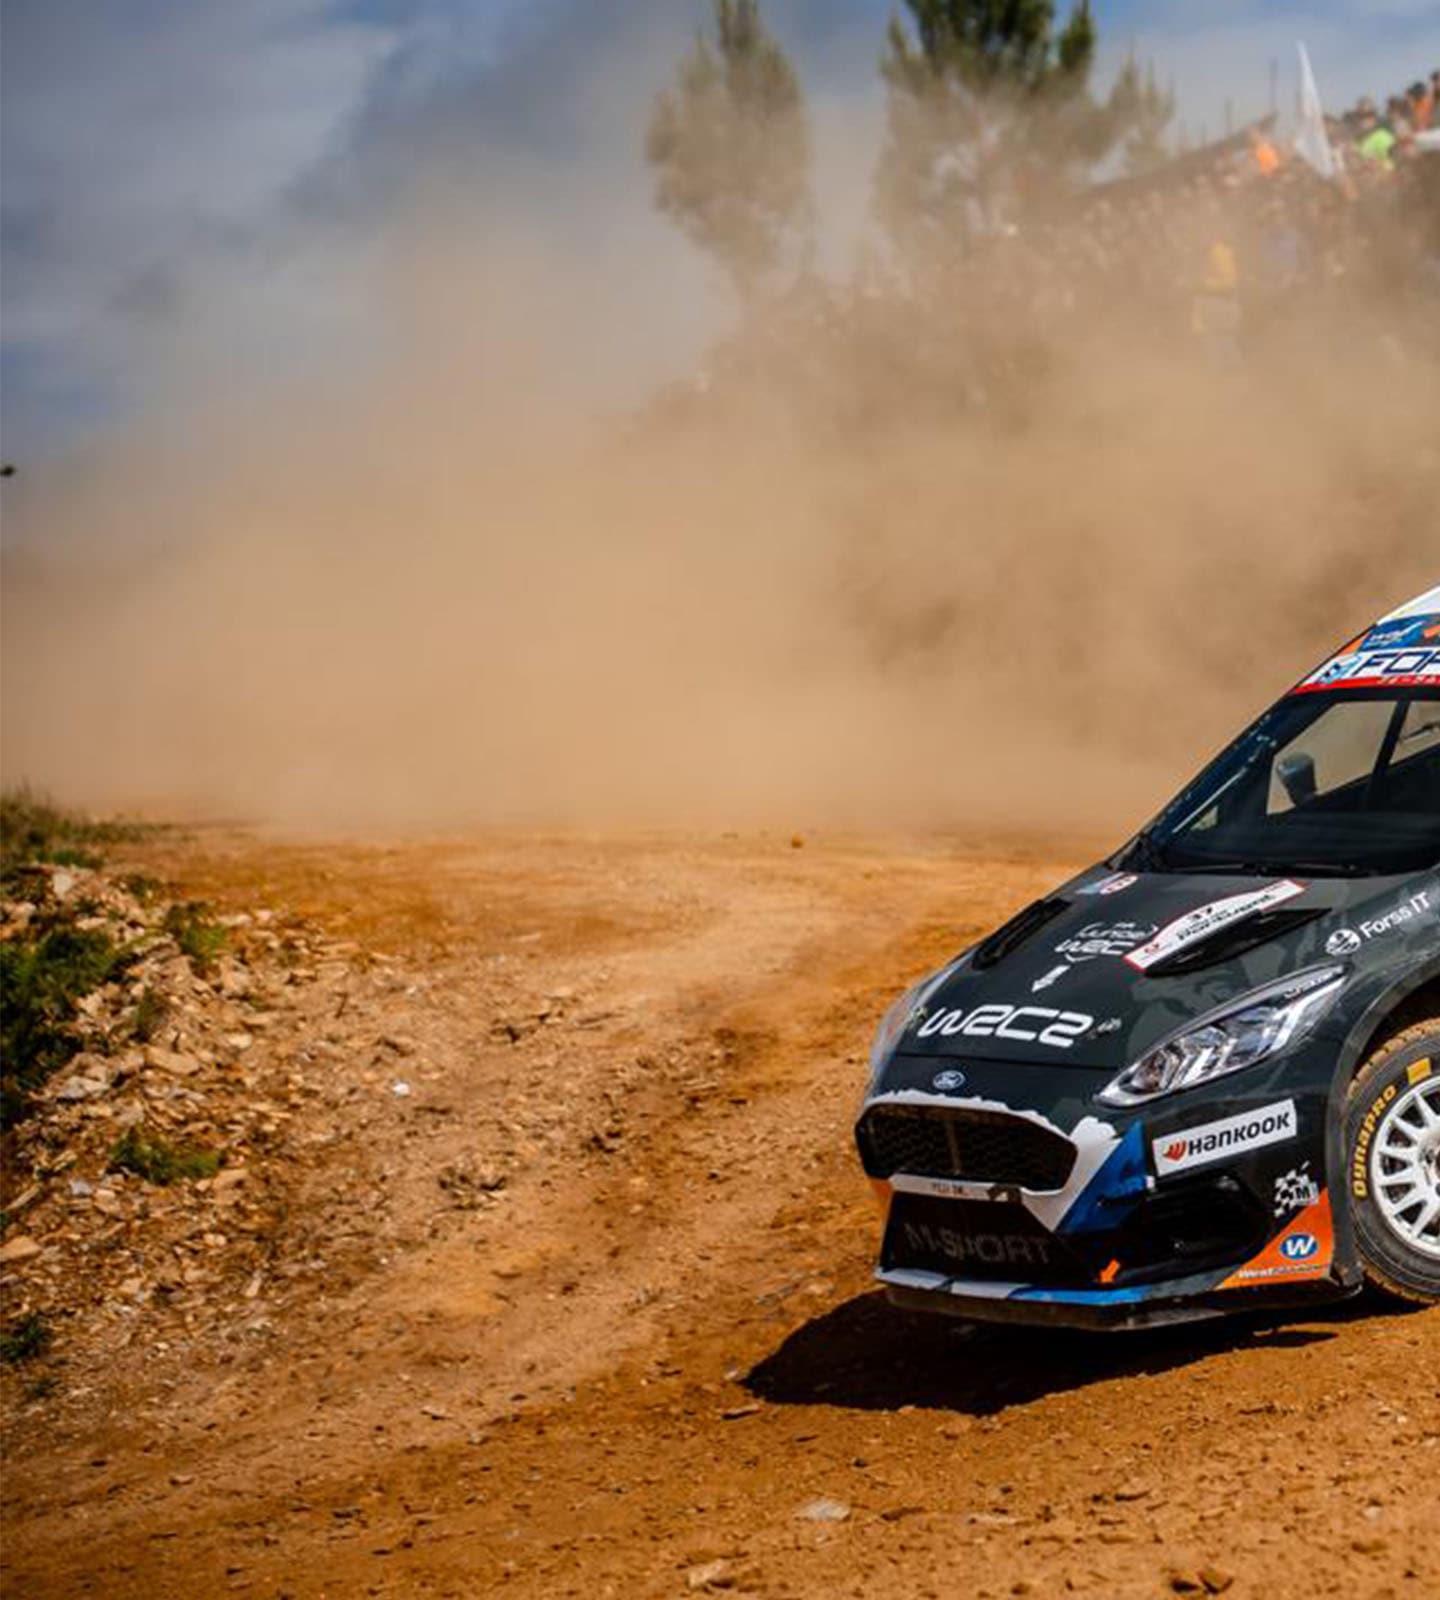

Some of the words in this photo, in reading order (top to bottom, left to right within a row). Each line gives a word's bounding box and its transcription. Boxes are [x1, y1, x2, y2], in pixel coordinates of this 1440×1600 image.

[1360, 904, 1414, 940] Forss
[1410, 891, 1431, 915] IT
[916, 1003, 1094, 1049] WRC2
[1285, 1235, 1316, 1257] W
